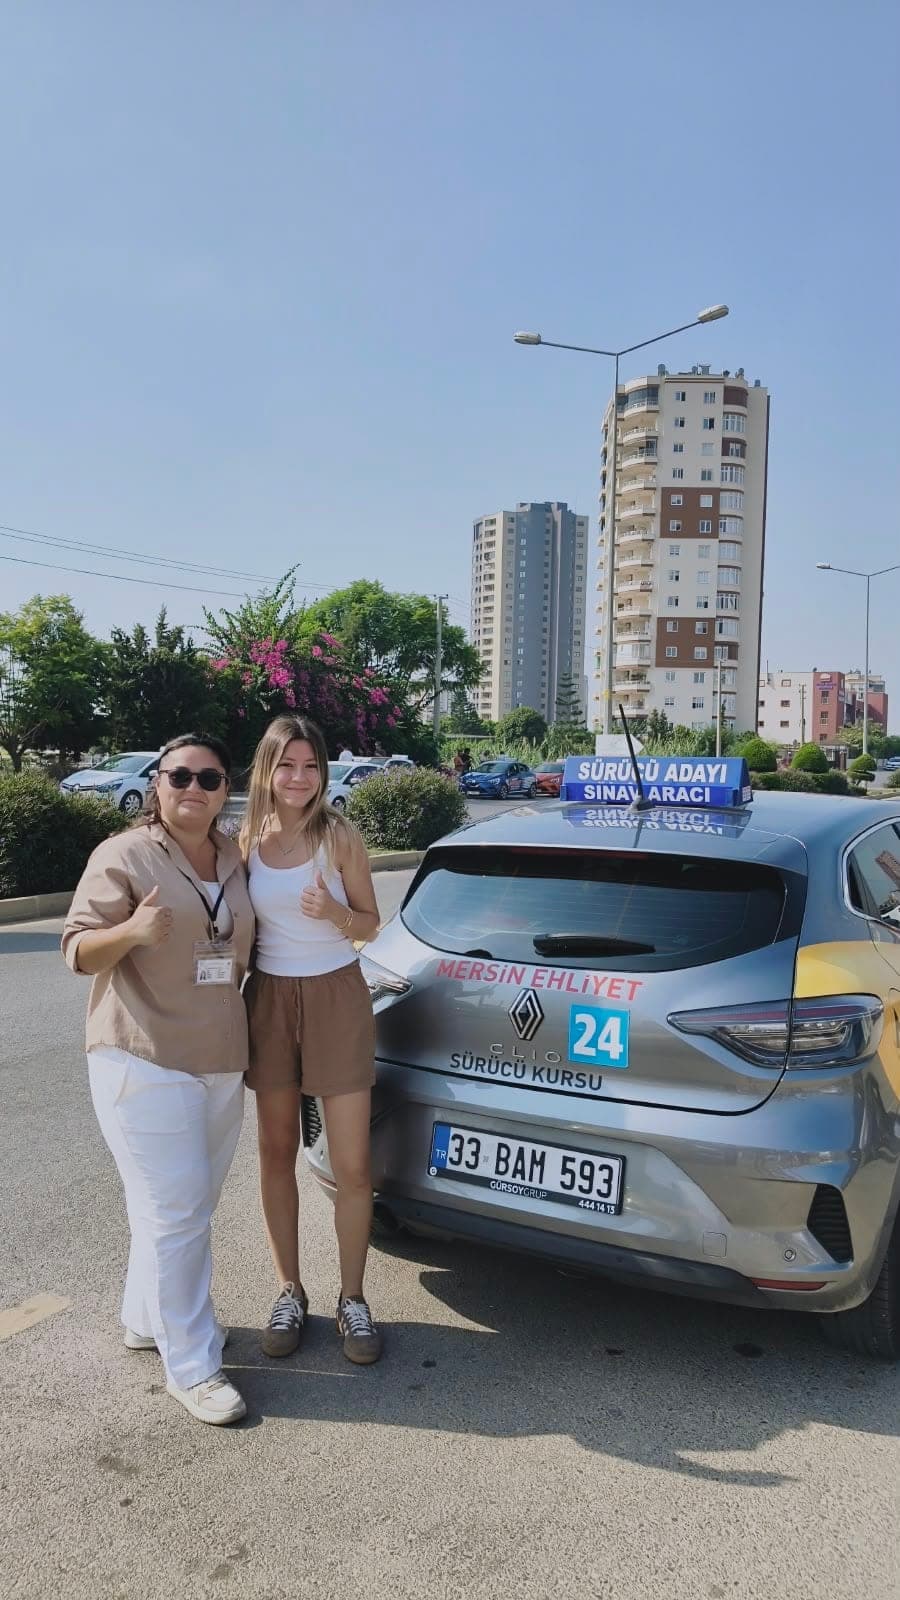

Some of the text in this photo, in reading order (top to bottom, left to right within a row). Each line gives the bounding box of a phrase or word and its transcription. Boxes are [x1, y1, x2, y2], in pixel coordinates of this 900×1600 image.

[664, 763, 728, 784] ADAYI
[647, 786, 711, 803] ARACI
[573, 1013, 624, 1060] 24
[489, 1043, 561, 1063] CLIO
[450, 1051, 603, 1091] SÜRÜCÜ KURSU
[435, 1148, 447, 1160] TR
[449, 1133, 614, 1199] 33 BAM 593
[578, 1200, 595, 1210] 444
[597, 1202, 605, 1212] 14
